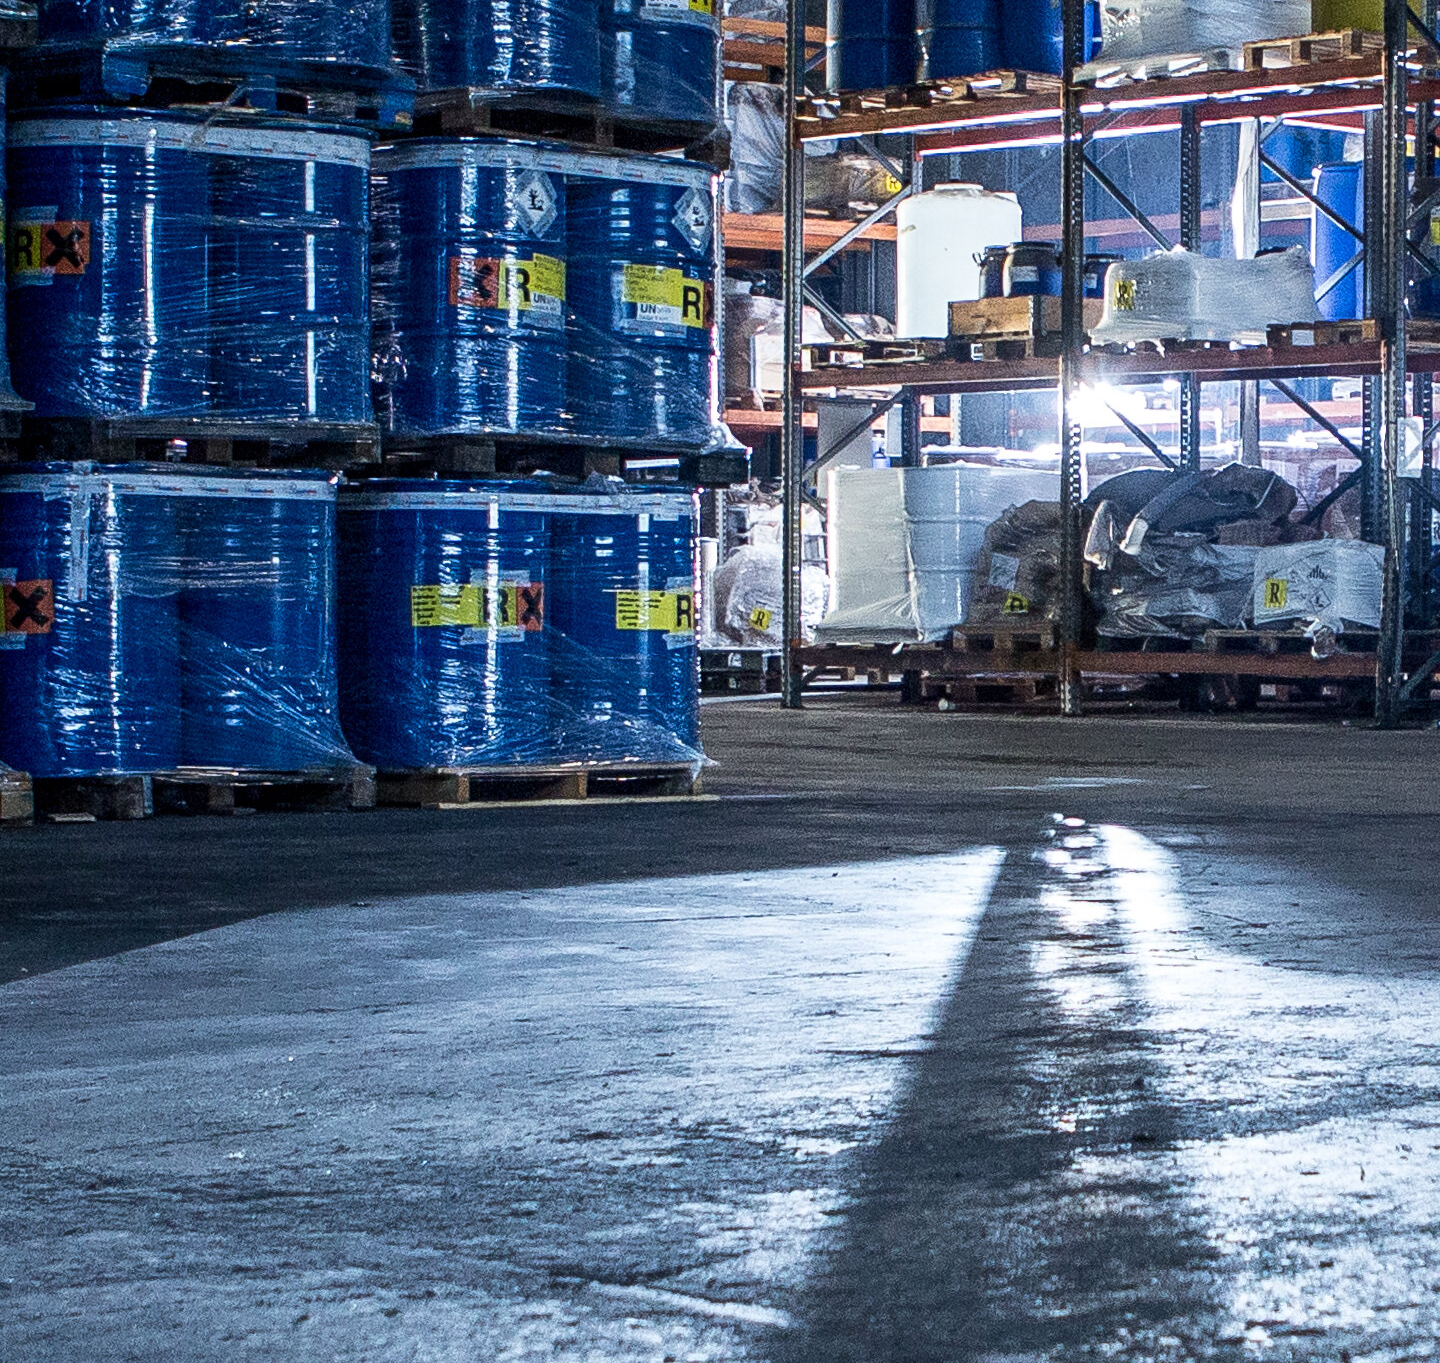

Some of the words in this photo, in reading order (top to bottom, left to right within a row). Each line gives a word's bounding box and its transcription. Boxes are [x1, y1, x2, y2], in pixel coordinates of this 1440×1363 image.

[14, 229, 33, 267] R
[683, 285, 701, 320] R
[1270, 582, 1282, 605] R
[677, 594, 691, 629] R
[753, 611, 766, 627] R
